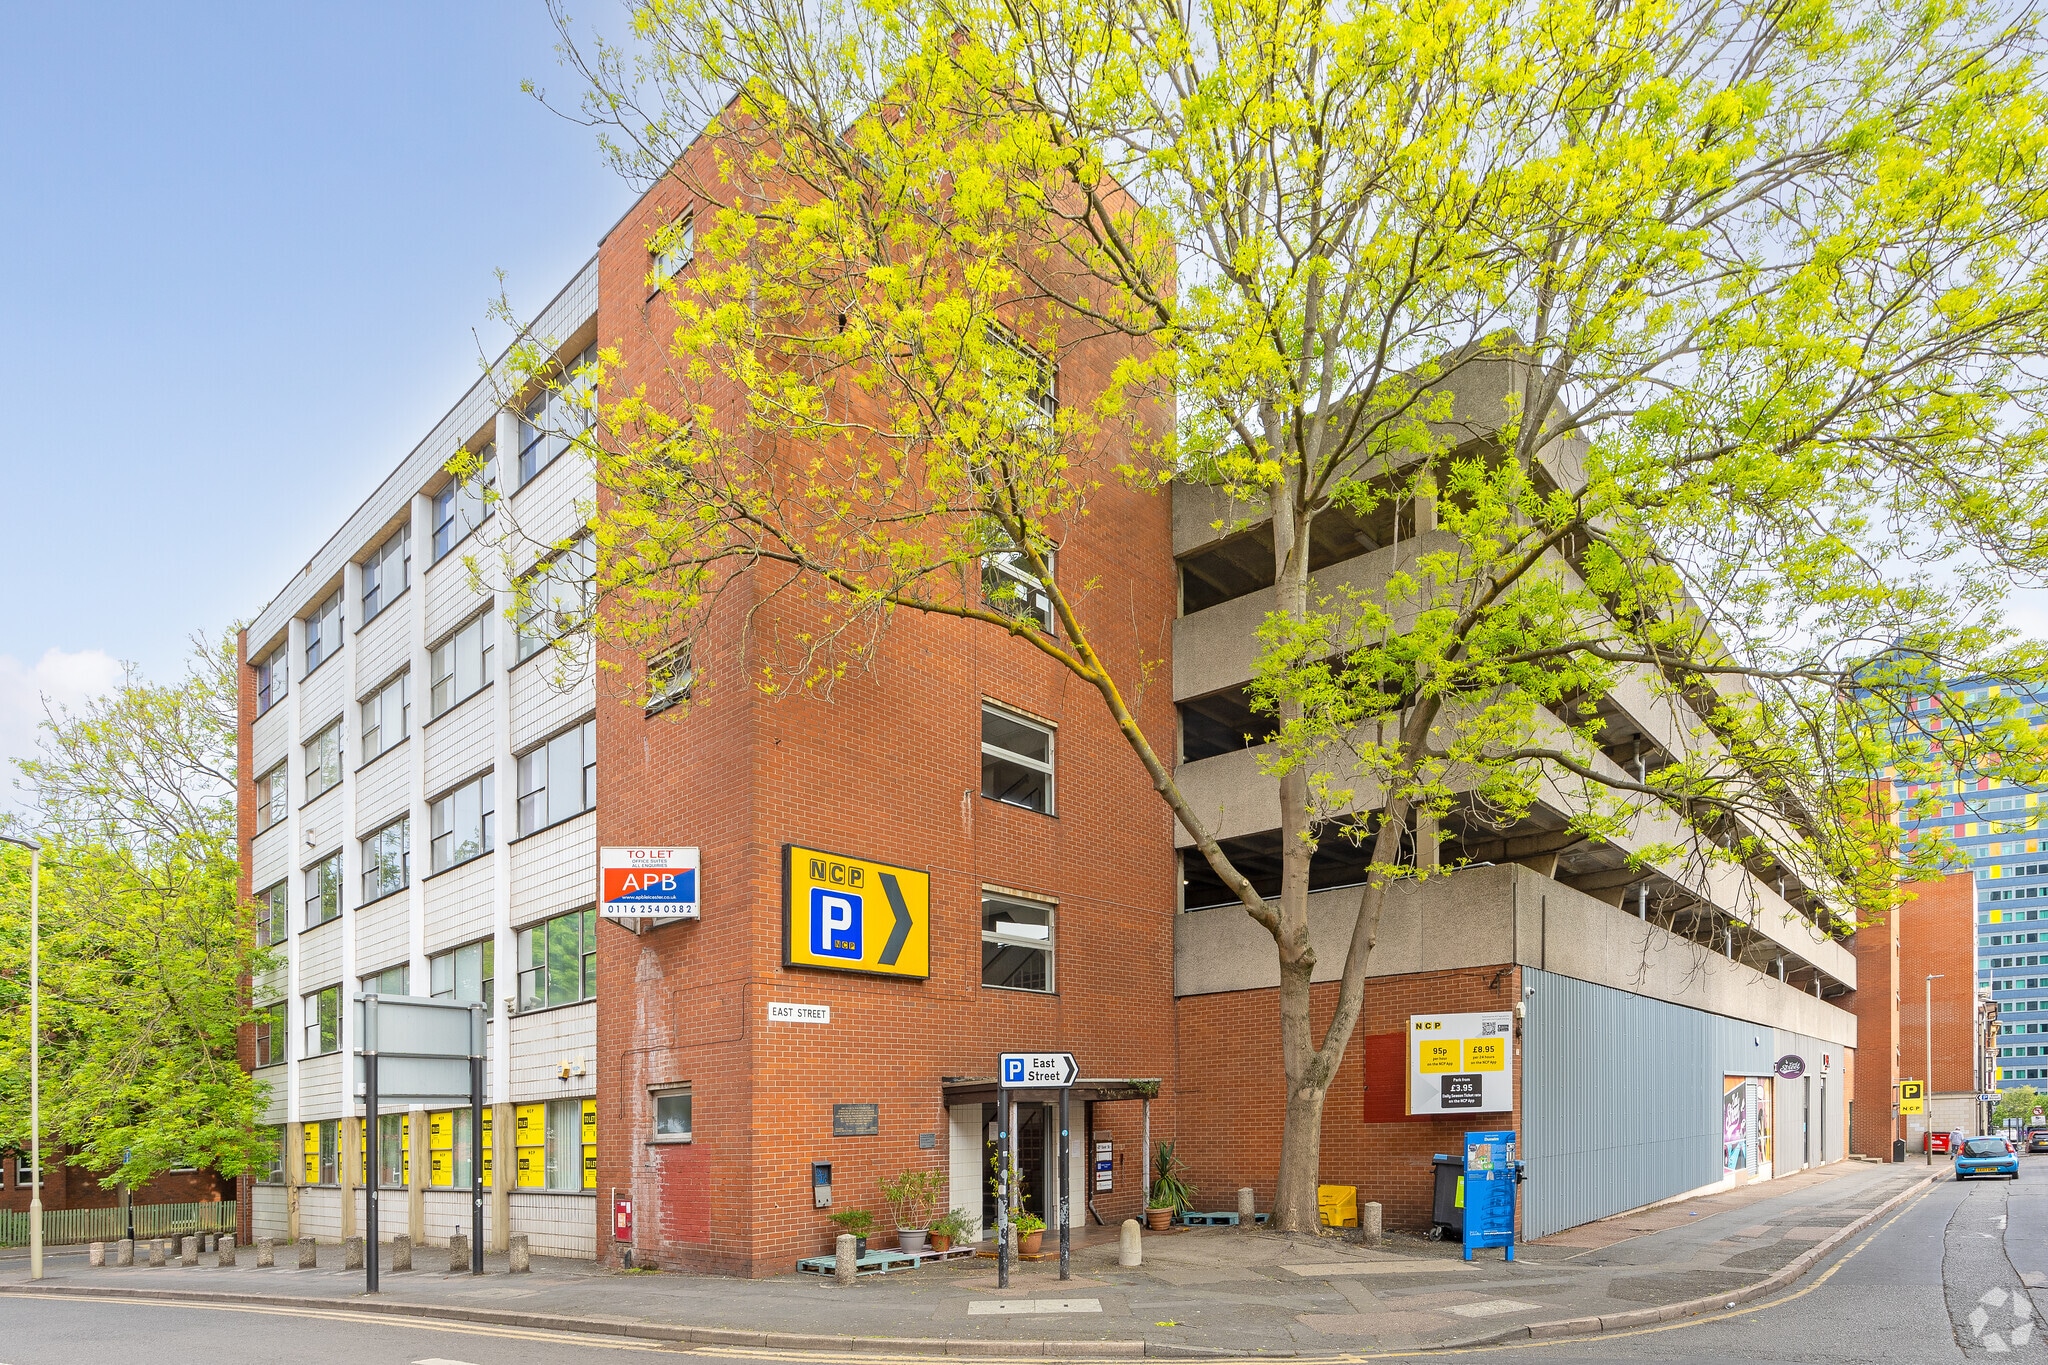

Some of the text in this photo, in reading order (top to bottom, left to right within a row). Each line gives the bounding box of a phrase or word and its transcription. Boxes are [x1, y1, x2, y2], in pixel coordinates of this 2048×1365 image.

[627, 850, 673, 858] TO LET
[811, 860, 862, 886] NCP
[622, 874, 677, 891] APB
[608, 905, 691, 913] 0116 254 0382
[822, 896, 852, 950] P
[834, 940, 856, 950] NCP
[772, 1006, 826, 1018] EAST STREET
[1416, 1022, 1441, 1030] NCP
[1433, 1048, 1447, 1056] 95p
[1033, 1058, 1055, 1067] East
[1010, 1061, 1022, 1080] P
[1028, 1071, 1060, 1080] Street
[1450, 1084, 1472, 1092] £3.95
[1906, 1086, 1917, 1097] P
